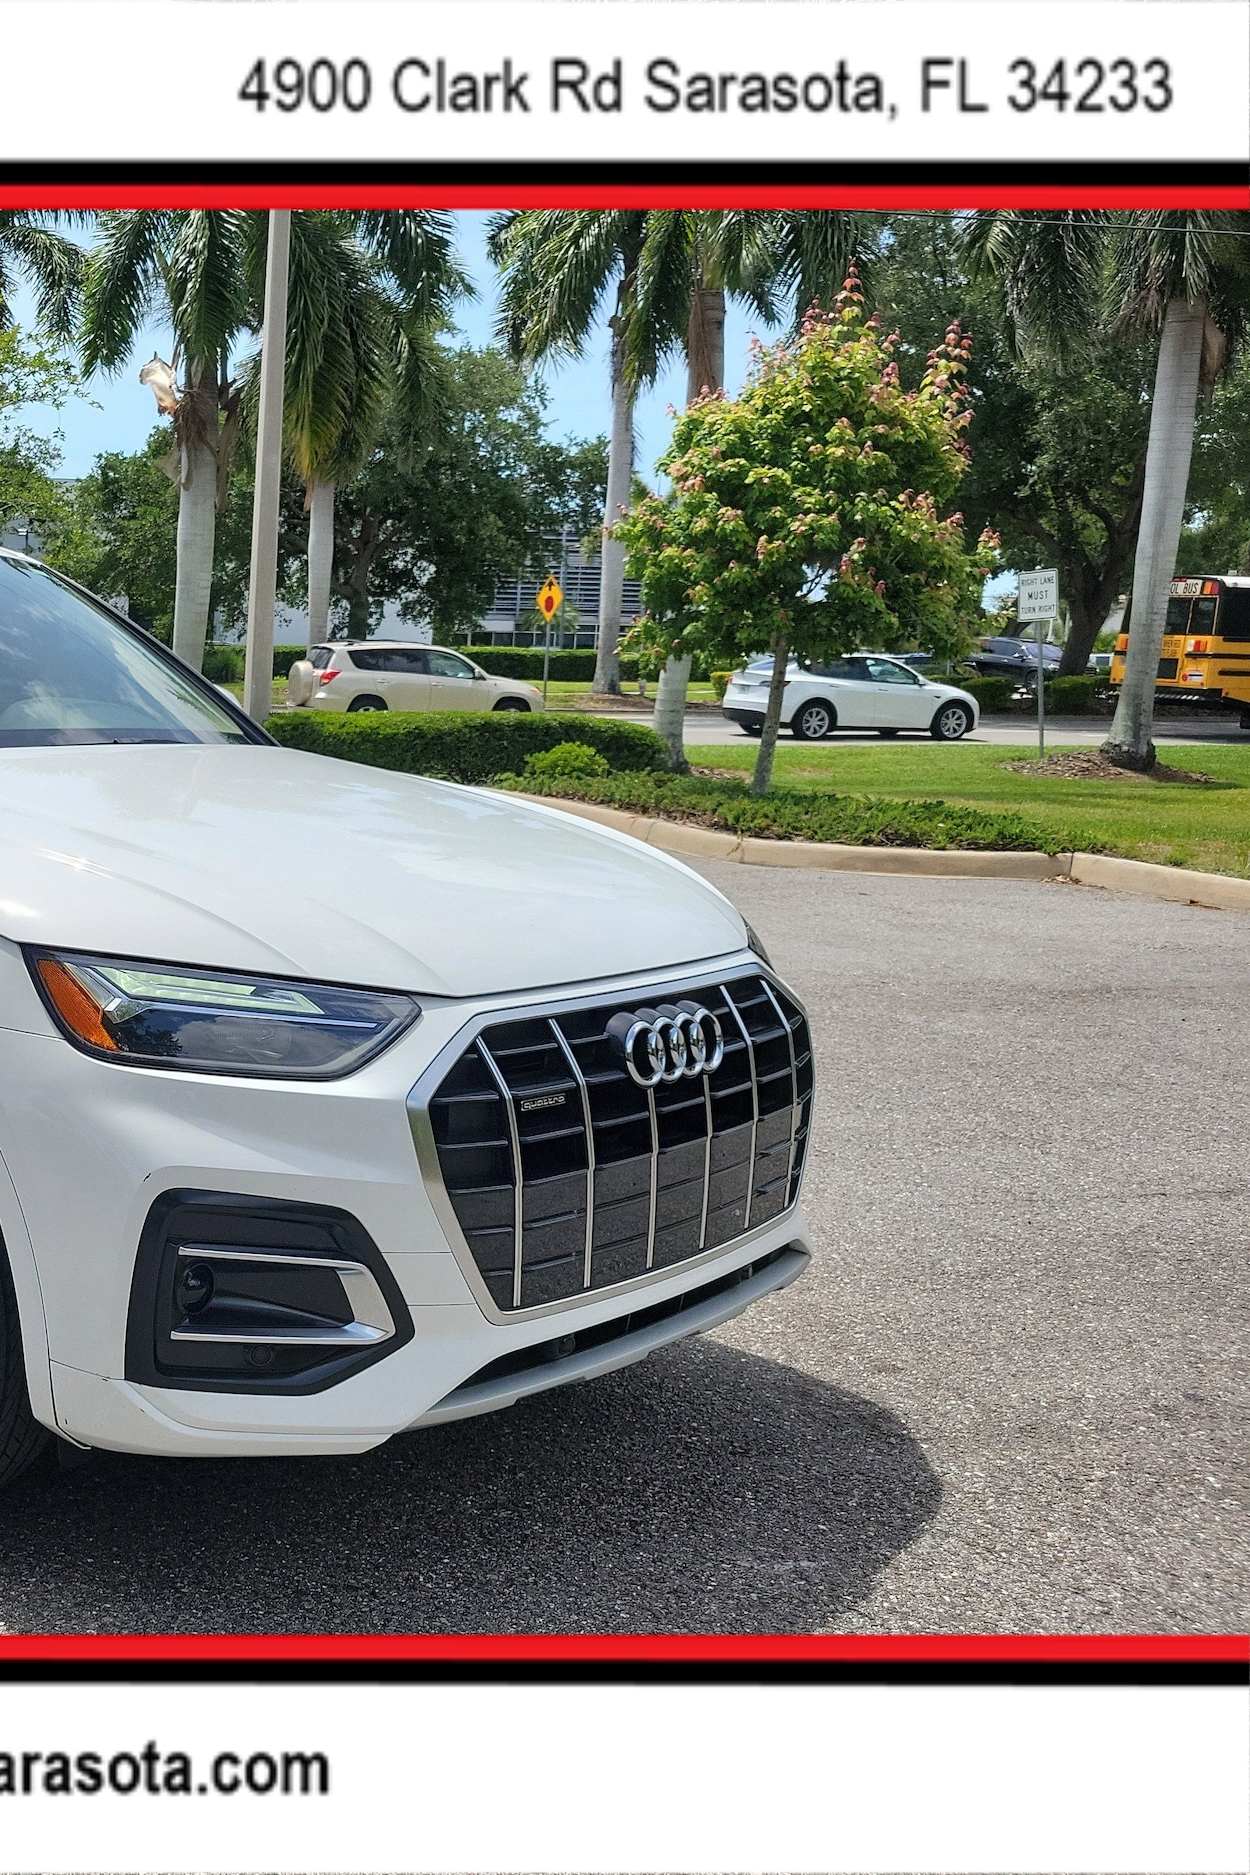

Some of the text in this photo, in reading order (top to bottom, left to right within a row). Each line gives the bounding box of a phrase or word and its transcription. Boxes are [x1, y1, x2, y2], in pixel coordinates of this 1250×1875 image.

[1021, 576, 1054, 586] RIGHT LANE
[1183, 582, 1198, 594] BUS
[1027, 590, 1048, 600] MUST
[1021, 604, 1055, 614] TURN RIGHT
